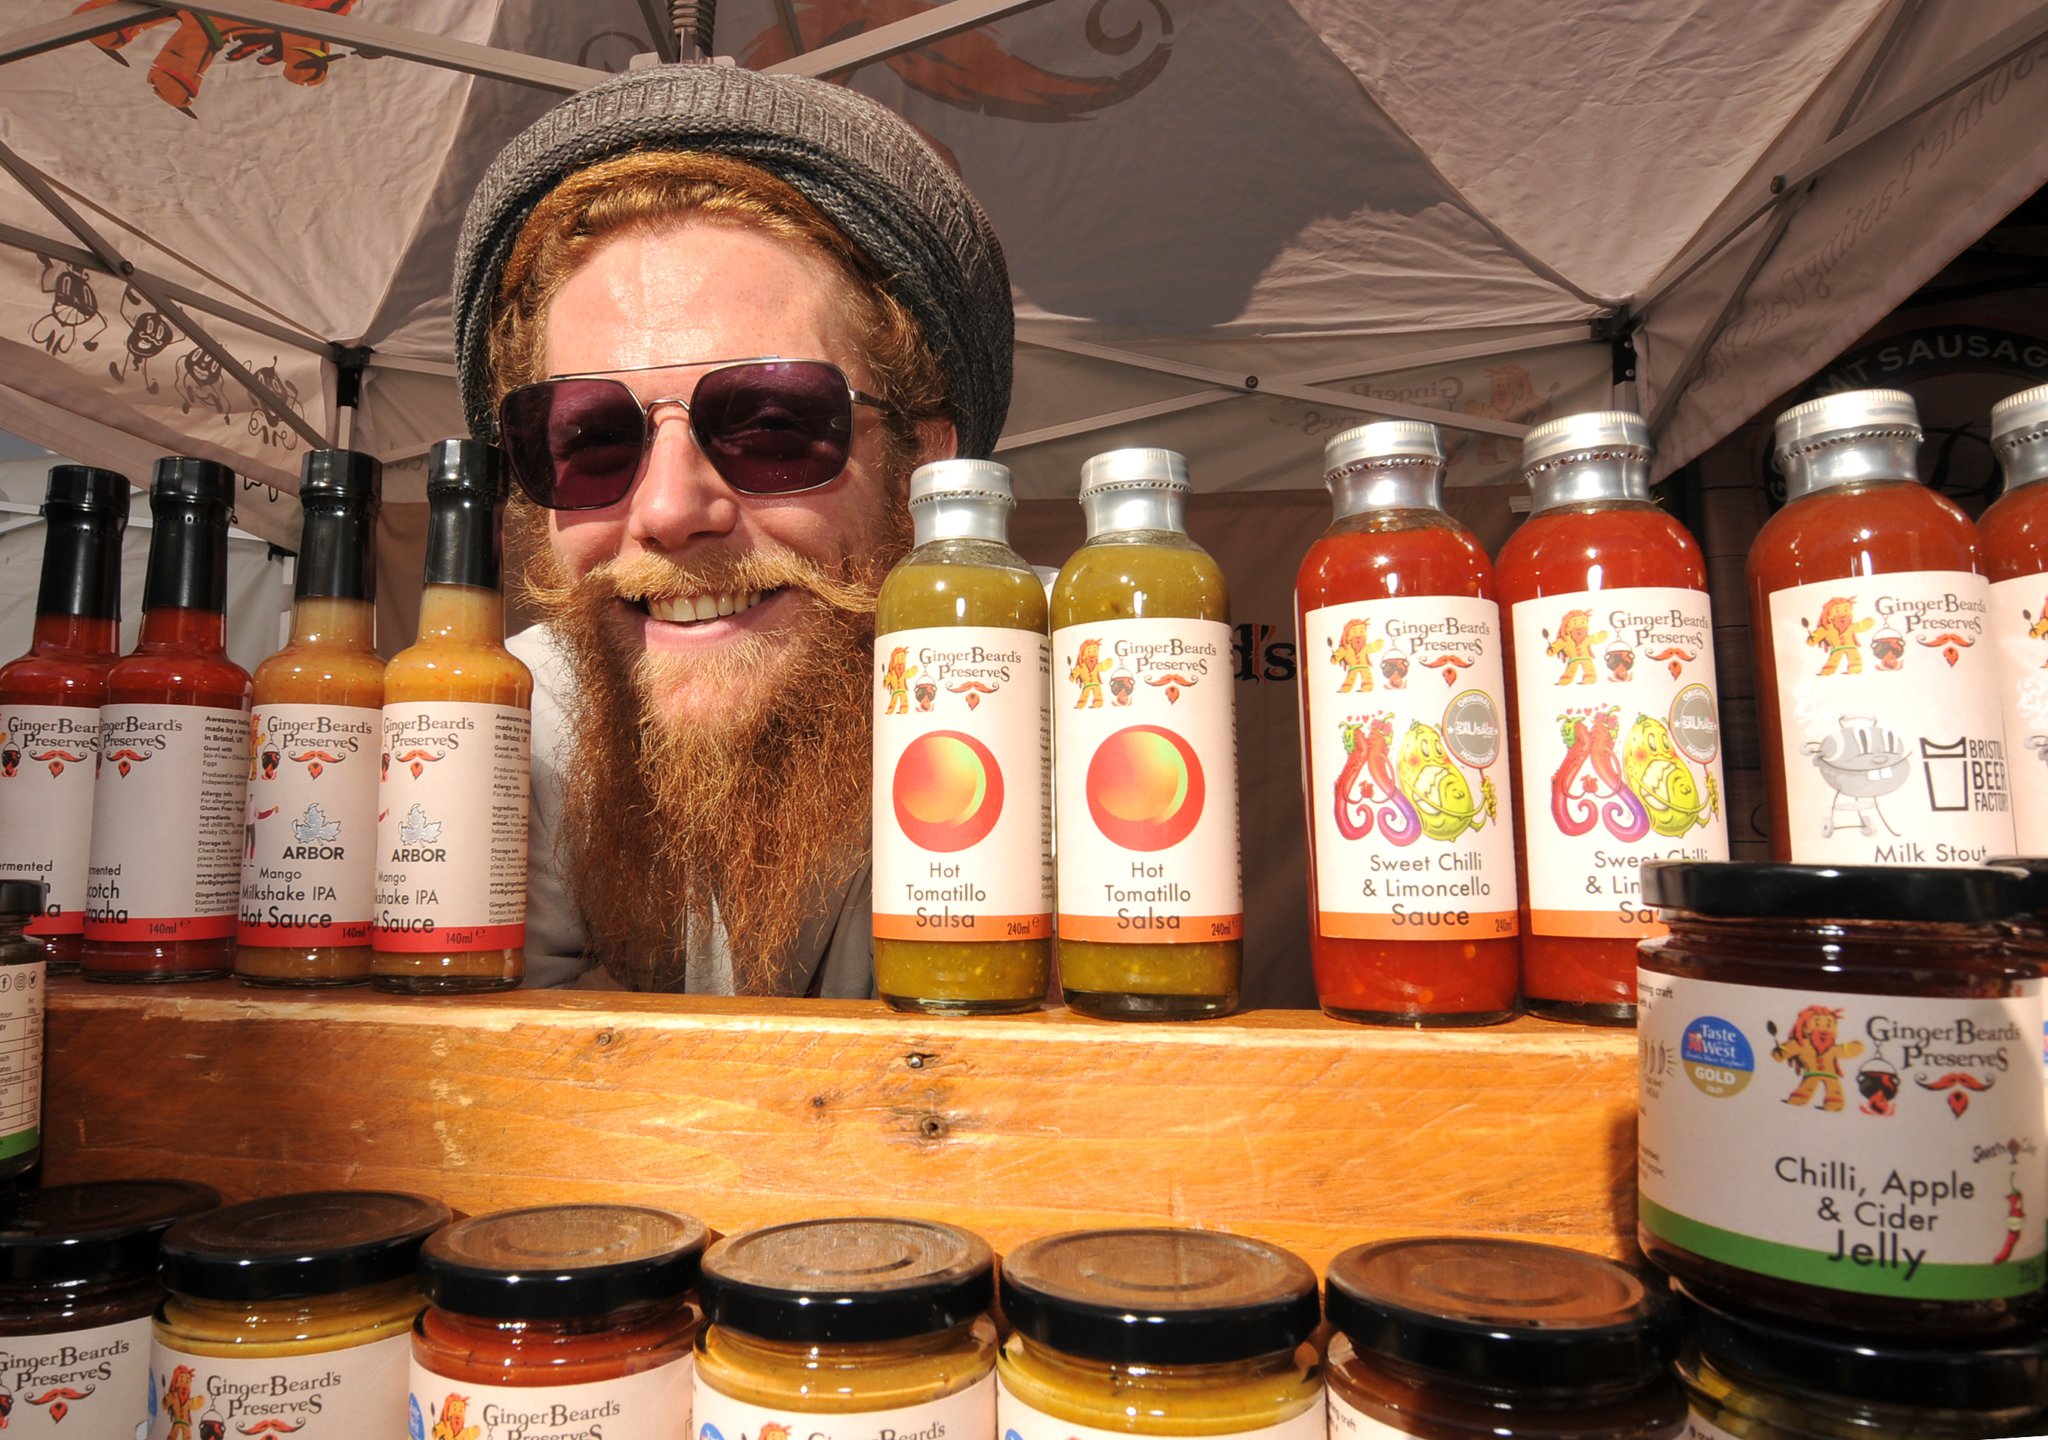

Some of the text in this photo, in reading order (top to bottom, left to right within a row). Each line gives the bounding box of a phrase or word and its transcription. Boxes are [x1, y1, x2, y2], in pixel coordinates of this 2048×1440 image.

[1878, 333, 2048, 373] SAUSAG
[1385, 617, 1491, 641] GingerBeard's
[1114, 638, 1217, 661] GingerBeard's
[1409, 635, 1484, 656] PreserveS
[919, 646, 1022, 670] GingerBeard's
[1136, 656, 1208, 675] PreserveS
[938, 664, 1010, 683] PreserveS
[8, 716, 99, 736] GingerBear
[267, 715, 373, 736] GingerBeard's
[384, 714, 475, 735] GingerBeard's
[104, 734, 166, 750] PreserveS
[282, 733, 359, 753] PreserveS
[391, 733, 459, 751] PreserveS
[1971, 761, 2007, 790] BEER
[282, 846, 345, 861] ARBOR
[391, 848, 446, 863] ARBOR
[1370, 853, 1483, 871] Sweet Chilli
[1875, 843, 1988, 863] Milk Stout
[0, 860, 53, 872] rmented
[259, 867, 302, 883] Mango
[929, 862, 960, 879] Hot
[1131, 862, 1164, 879] Hot
[379, 873, 406, 886] Mango
[1362, 876, 1491, 896] & Limoncello
[1586, 875, 1602, 894] &
[86, 880, 120, 899] cotch
[242, 885, 337, 902] Milkshake IPA
[416, 890, 439, 905] IPA
[906, 884, 986, 902] Tomatillo
[1104, 884, 1191, 902] Tomatillo
[241, 905, 332, 928] Hot Sauce
[382, 910, 435, 933] Sauce
[916, 907, 975, 928] Salsa
[1117, 907, 1180, 929] Salsa
[1391, 903, 1470, 926] Sauce
[149, 922, 177, 934] 140ml
[343, 927, 366, 938] 140ml
[1007, 921, 1030, 936] 240ml
[1211, 921, 1231, 936] 240ml
[446, 933, 473, 944] 140ml
[1700, 1023, 1737, 1042] Taste
[1702, 1041, 1737, 1058] West
[1902, 1045, 2009, 1072] PreserveS
[1695, 1067, 1736, 1085] GOLD
[1775, 1156, 1975, 1207] Chilli, Apple
[1817, 1196, 1939, 1231] & Cider
[1827, 1229, 1927, 1281] Jelly
[15, 1361, 111, 1392] PreserveS
[206, 1372, 341, 1402] GingerBeard's
[227, 1394, 322, 1420] PreserveS
[483, 1400, 620, 1432] GingerBeard's
